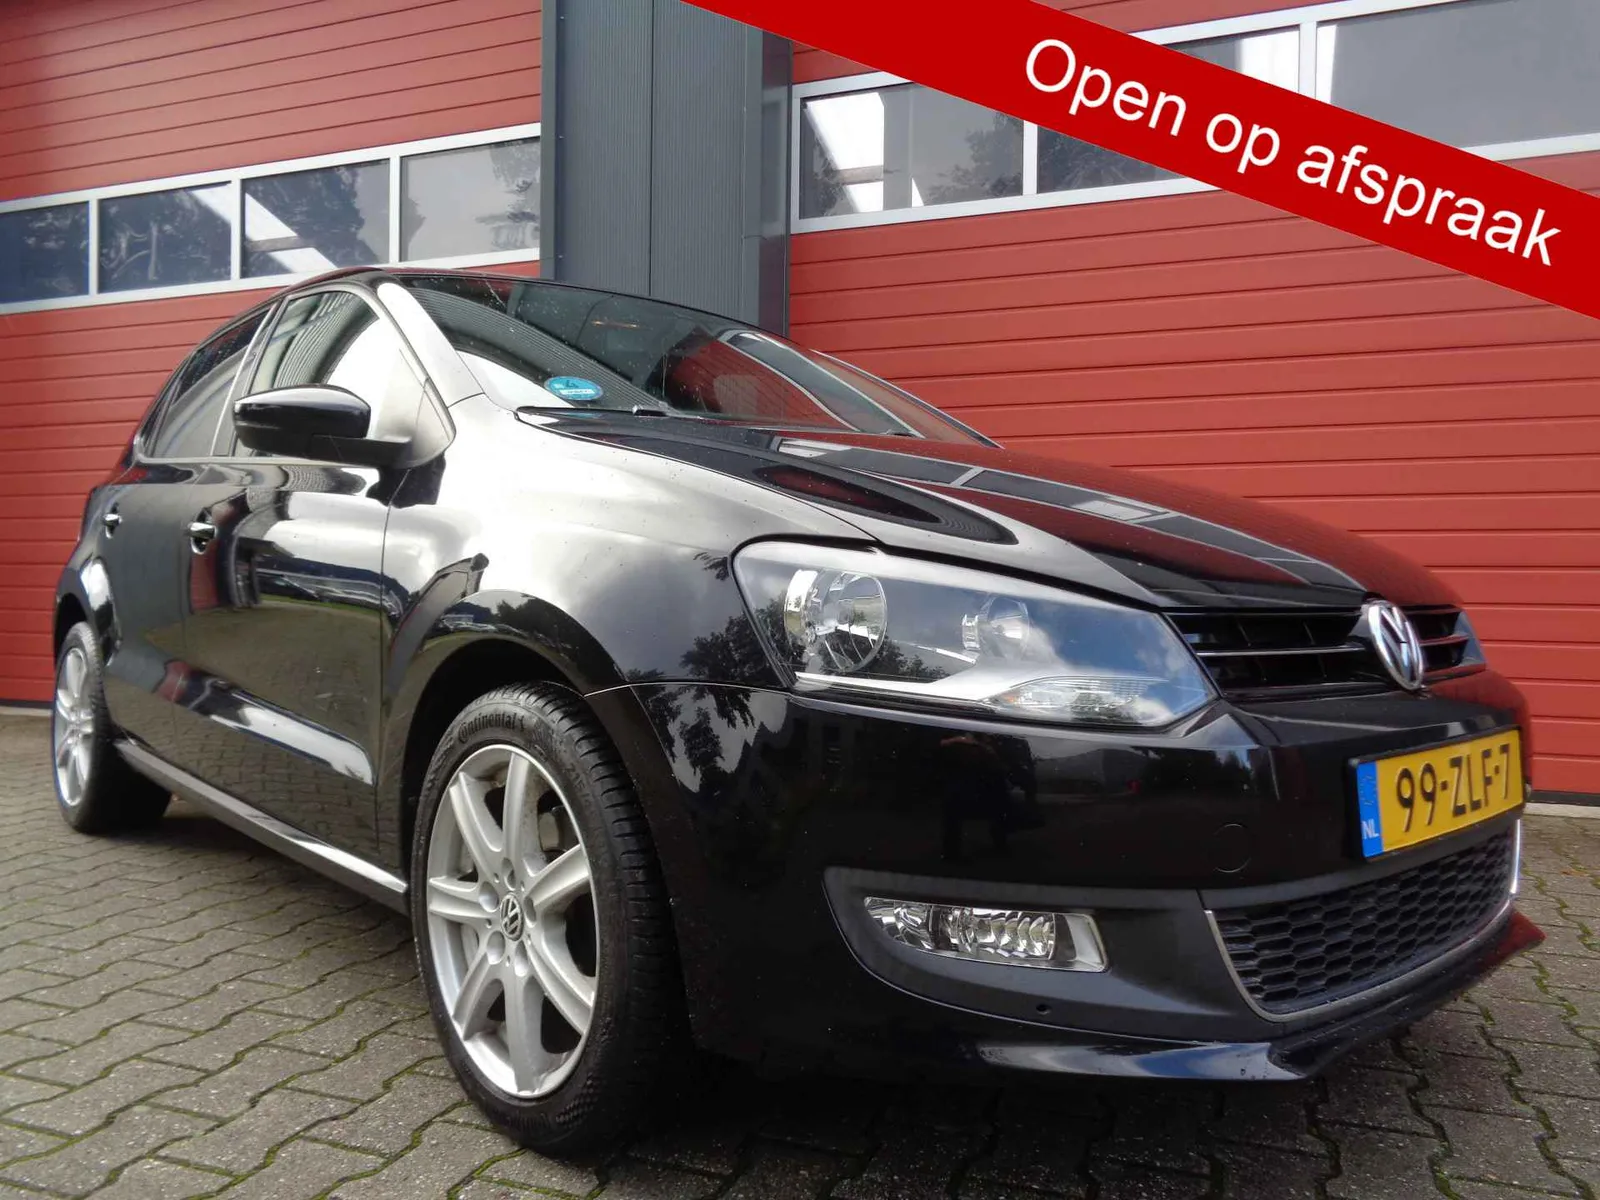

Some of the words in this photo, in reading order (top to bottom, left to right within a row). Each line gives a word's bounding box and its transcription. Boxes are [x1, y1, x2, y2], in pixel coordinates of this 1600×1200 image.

[458, 712, 517, 744] Continental
[1396, 743, 1511, 833] 99-ZLF-7
[1362, 820, 1379, 839] NL
